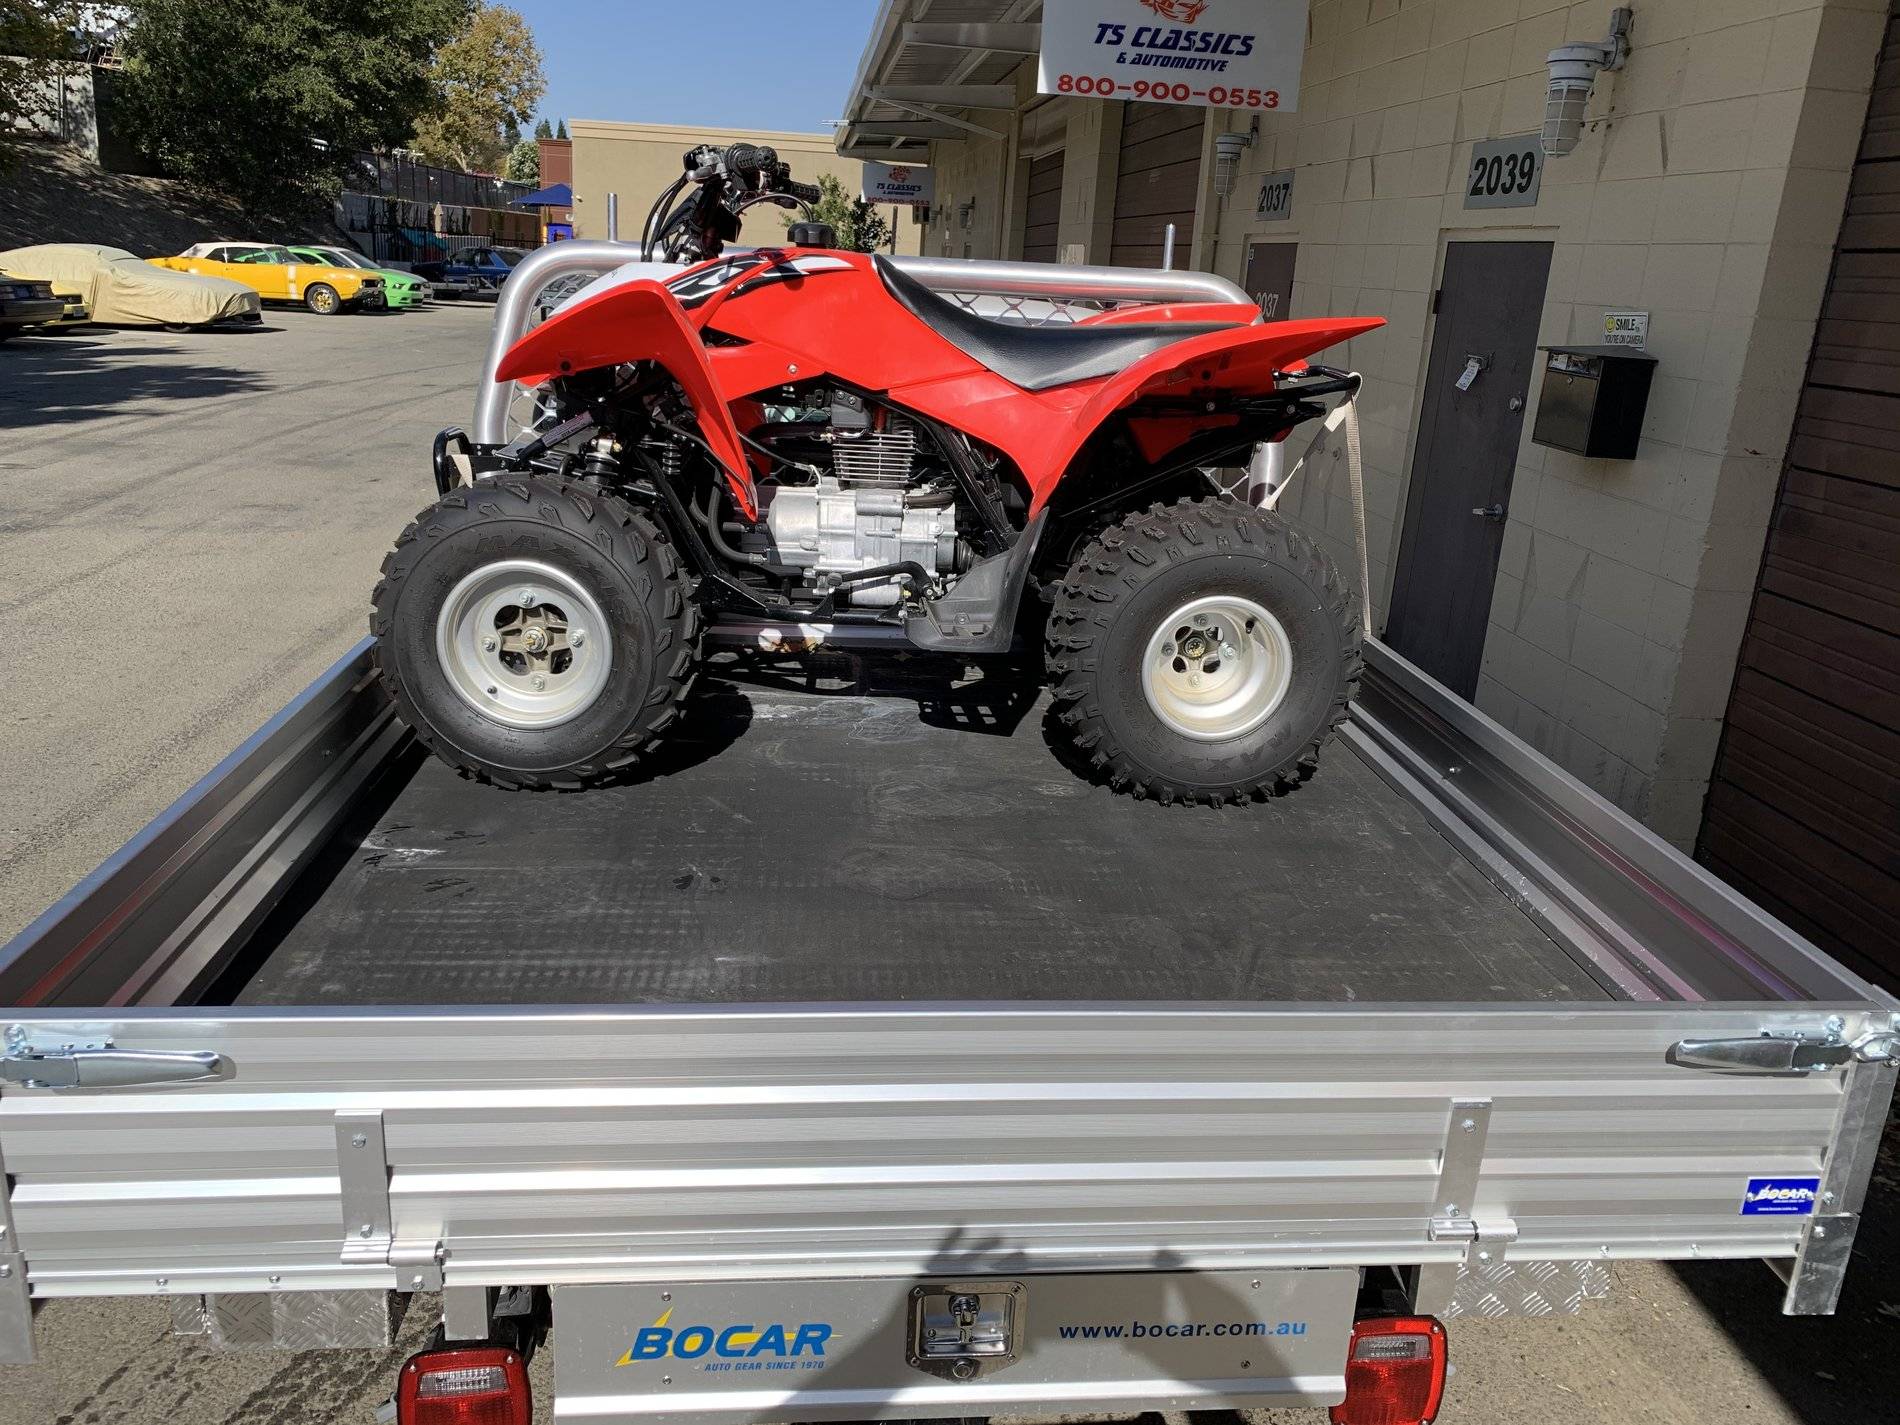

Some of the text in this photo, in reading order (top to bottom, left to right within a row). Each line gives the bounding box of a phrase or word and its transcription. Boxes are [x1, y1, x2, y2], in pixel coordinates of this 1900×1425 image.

[1094, 23, 1126, 46] TS
[1116, 51, 1229, 73] & AUTOMOTIVE
[1057, 74, 1280, 109] 800-900-0553
[1469, 151, 1535, 196] 2039
[1258, 183, 1289, 212] 2037
[1615, 318, 1636, 331] SMILE
[1059, 1321, 1307, 1339] www.bocar.com.au
[630, 1323, 833, 1361] BOCAR
[704, 1360, 825, 1372] AUTO GEAR SINCE 1970
